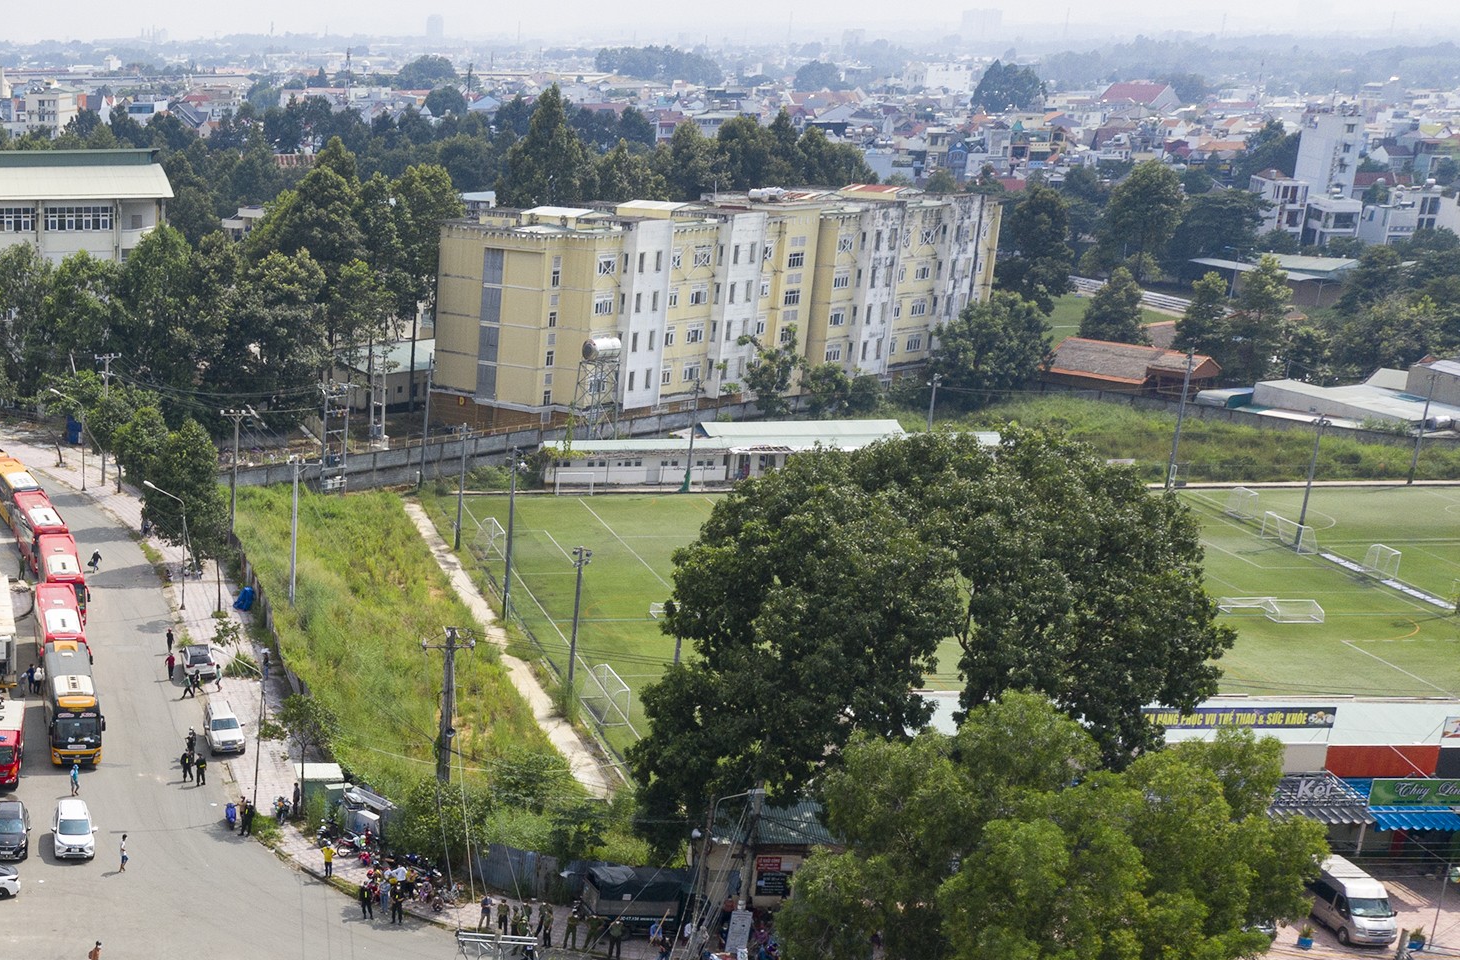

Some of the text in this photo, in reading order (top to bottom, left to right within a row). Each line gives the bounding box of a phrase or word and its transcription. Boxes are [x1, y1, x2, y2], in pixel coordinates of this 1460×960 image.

[1156, 711, 1179, 725] HÀNG
[1205, 712, 1217, 727] VỤ
[1236, 712, 1257, 725] THAO
[1258, 714, 1264, 725] &
[1266, 711, 1284, 725] SỨC
